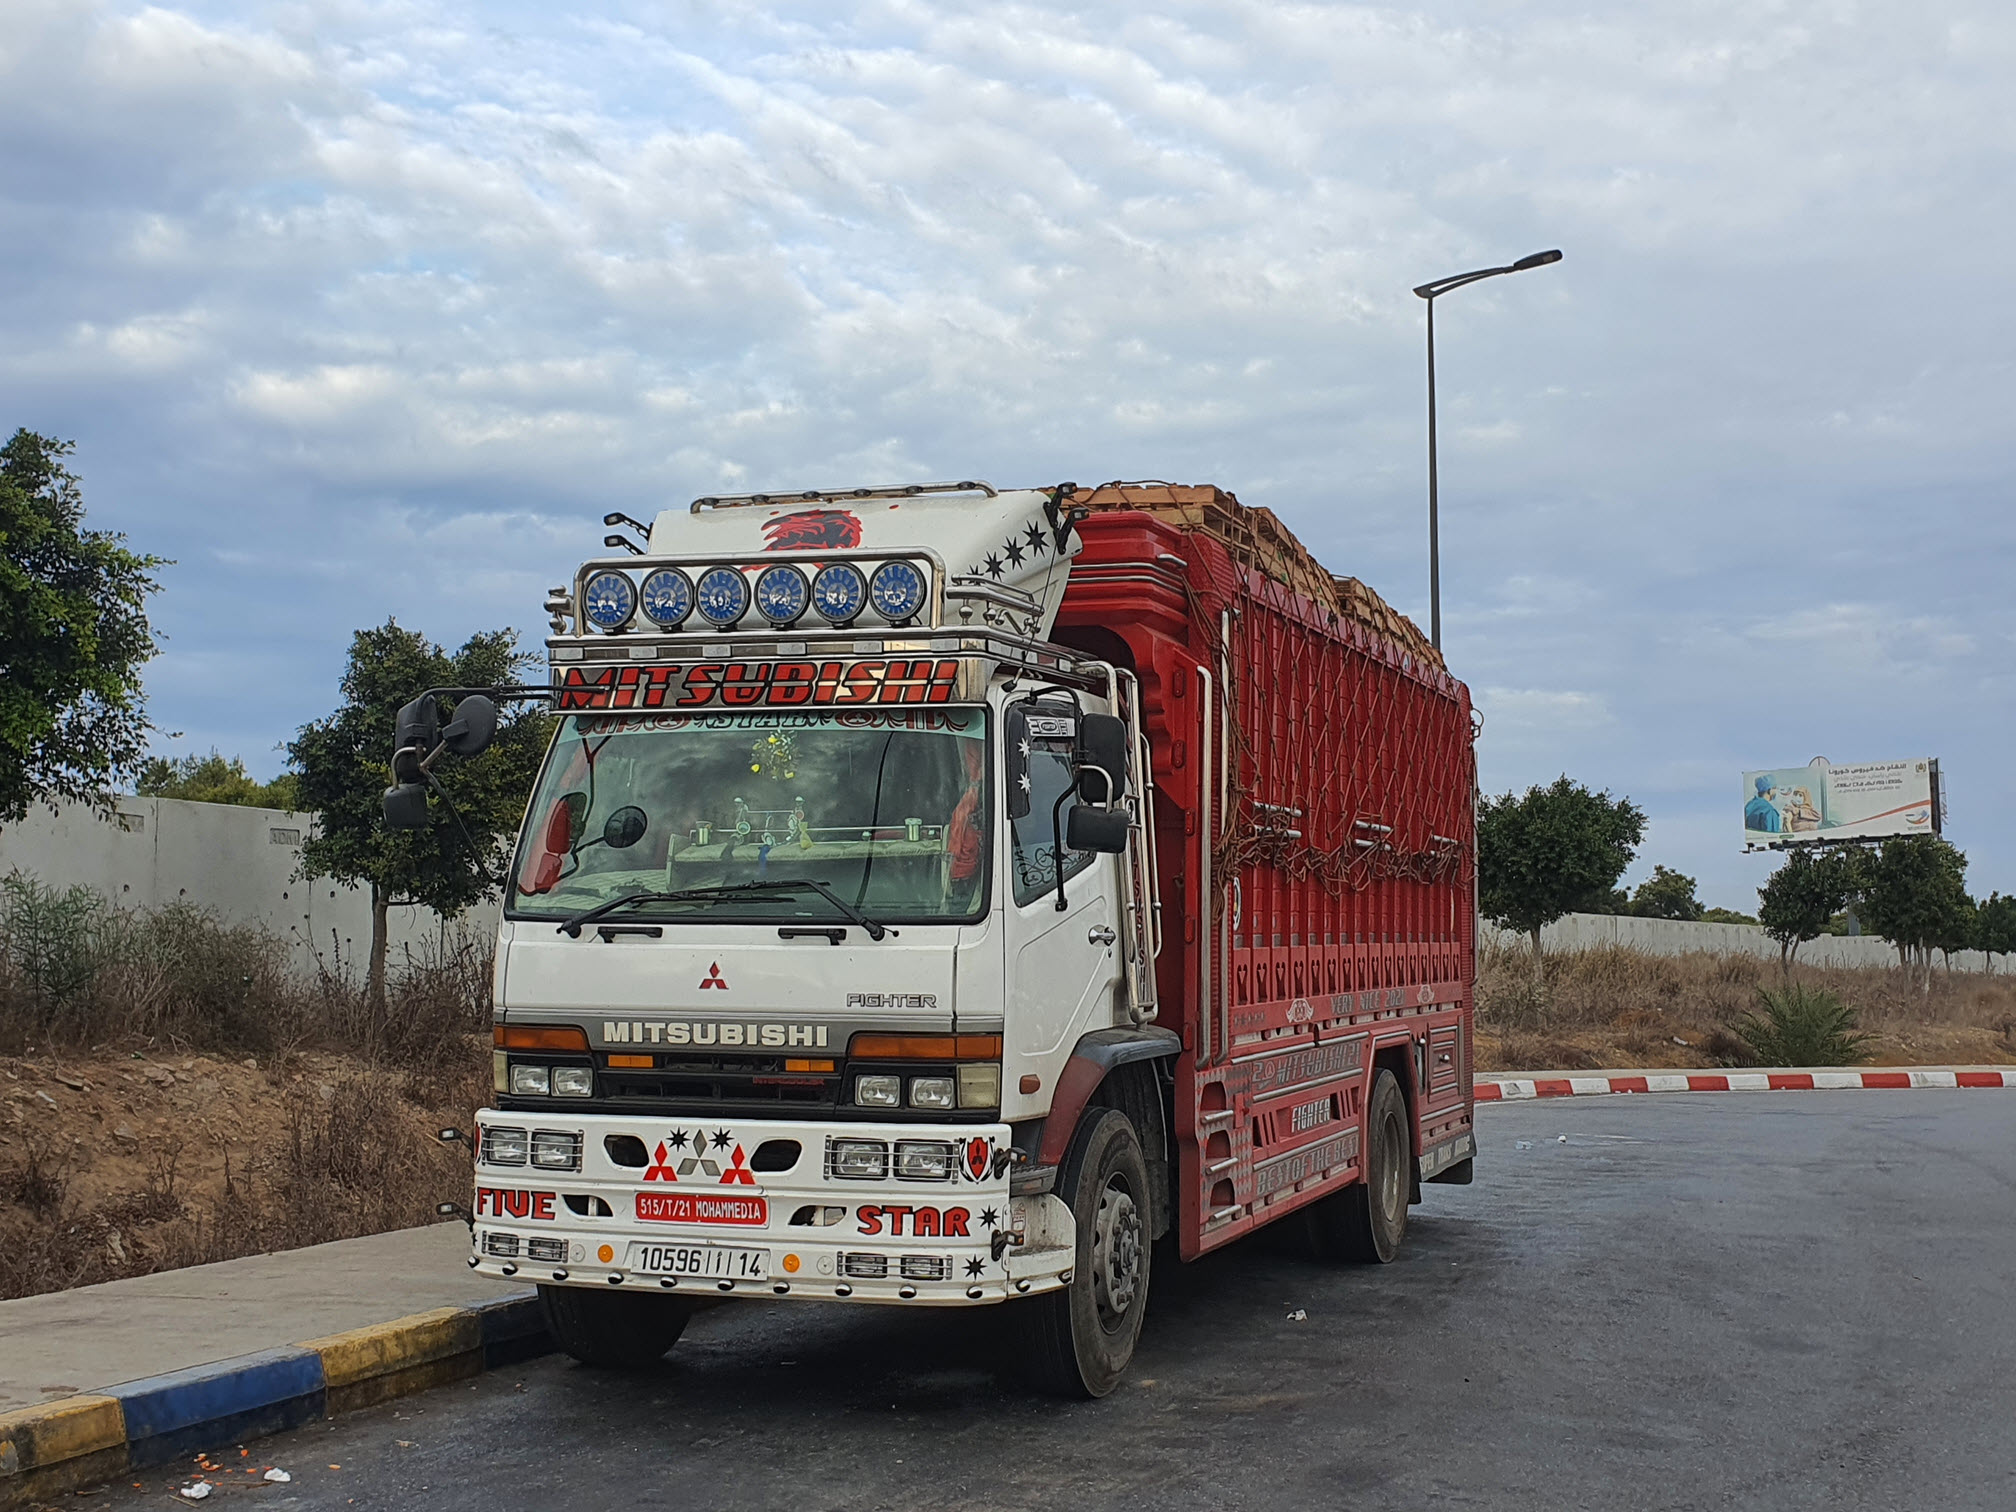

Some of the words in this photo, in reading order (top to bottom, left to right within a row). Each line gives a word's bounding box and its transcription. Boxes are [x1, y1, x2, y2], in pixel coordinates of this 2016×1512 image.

[559, 660, 958, 709] MITSUBISHI
[846, 993, 937, 1008] FIGHTER
[1331, 994, 1354, 1015] VERY
[603, 1021, 829, 1047] MITSUBISHI
[1291, 1098, 1331, 1134] FIGHTER
[1310, 1145, 1332, 1175] THE
[477, 1186, 556, 1220] FIVE
[640, 1198, 690, 1217] 515/T/21
[695, 1200, 761, 1219] MOHAMMEDIA
[856, 1205, 971, 1237] STAR
[641, 1247, 702, 1273] 10596
[739, 1252, 760, 1276] 14
